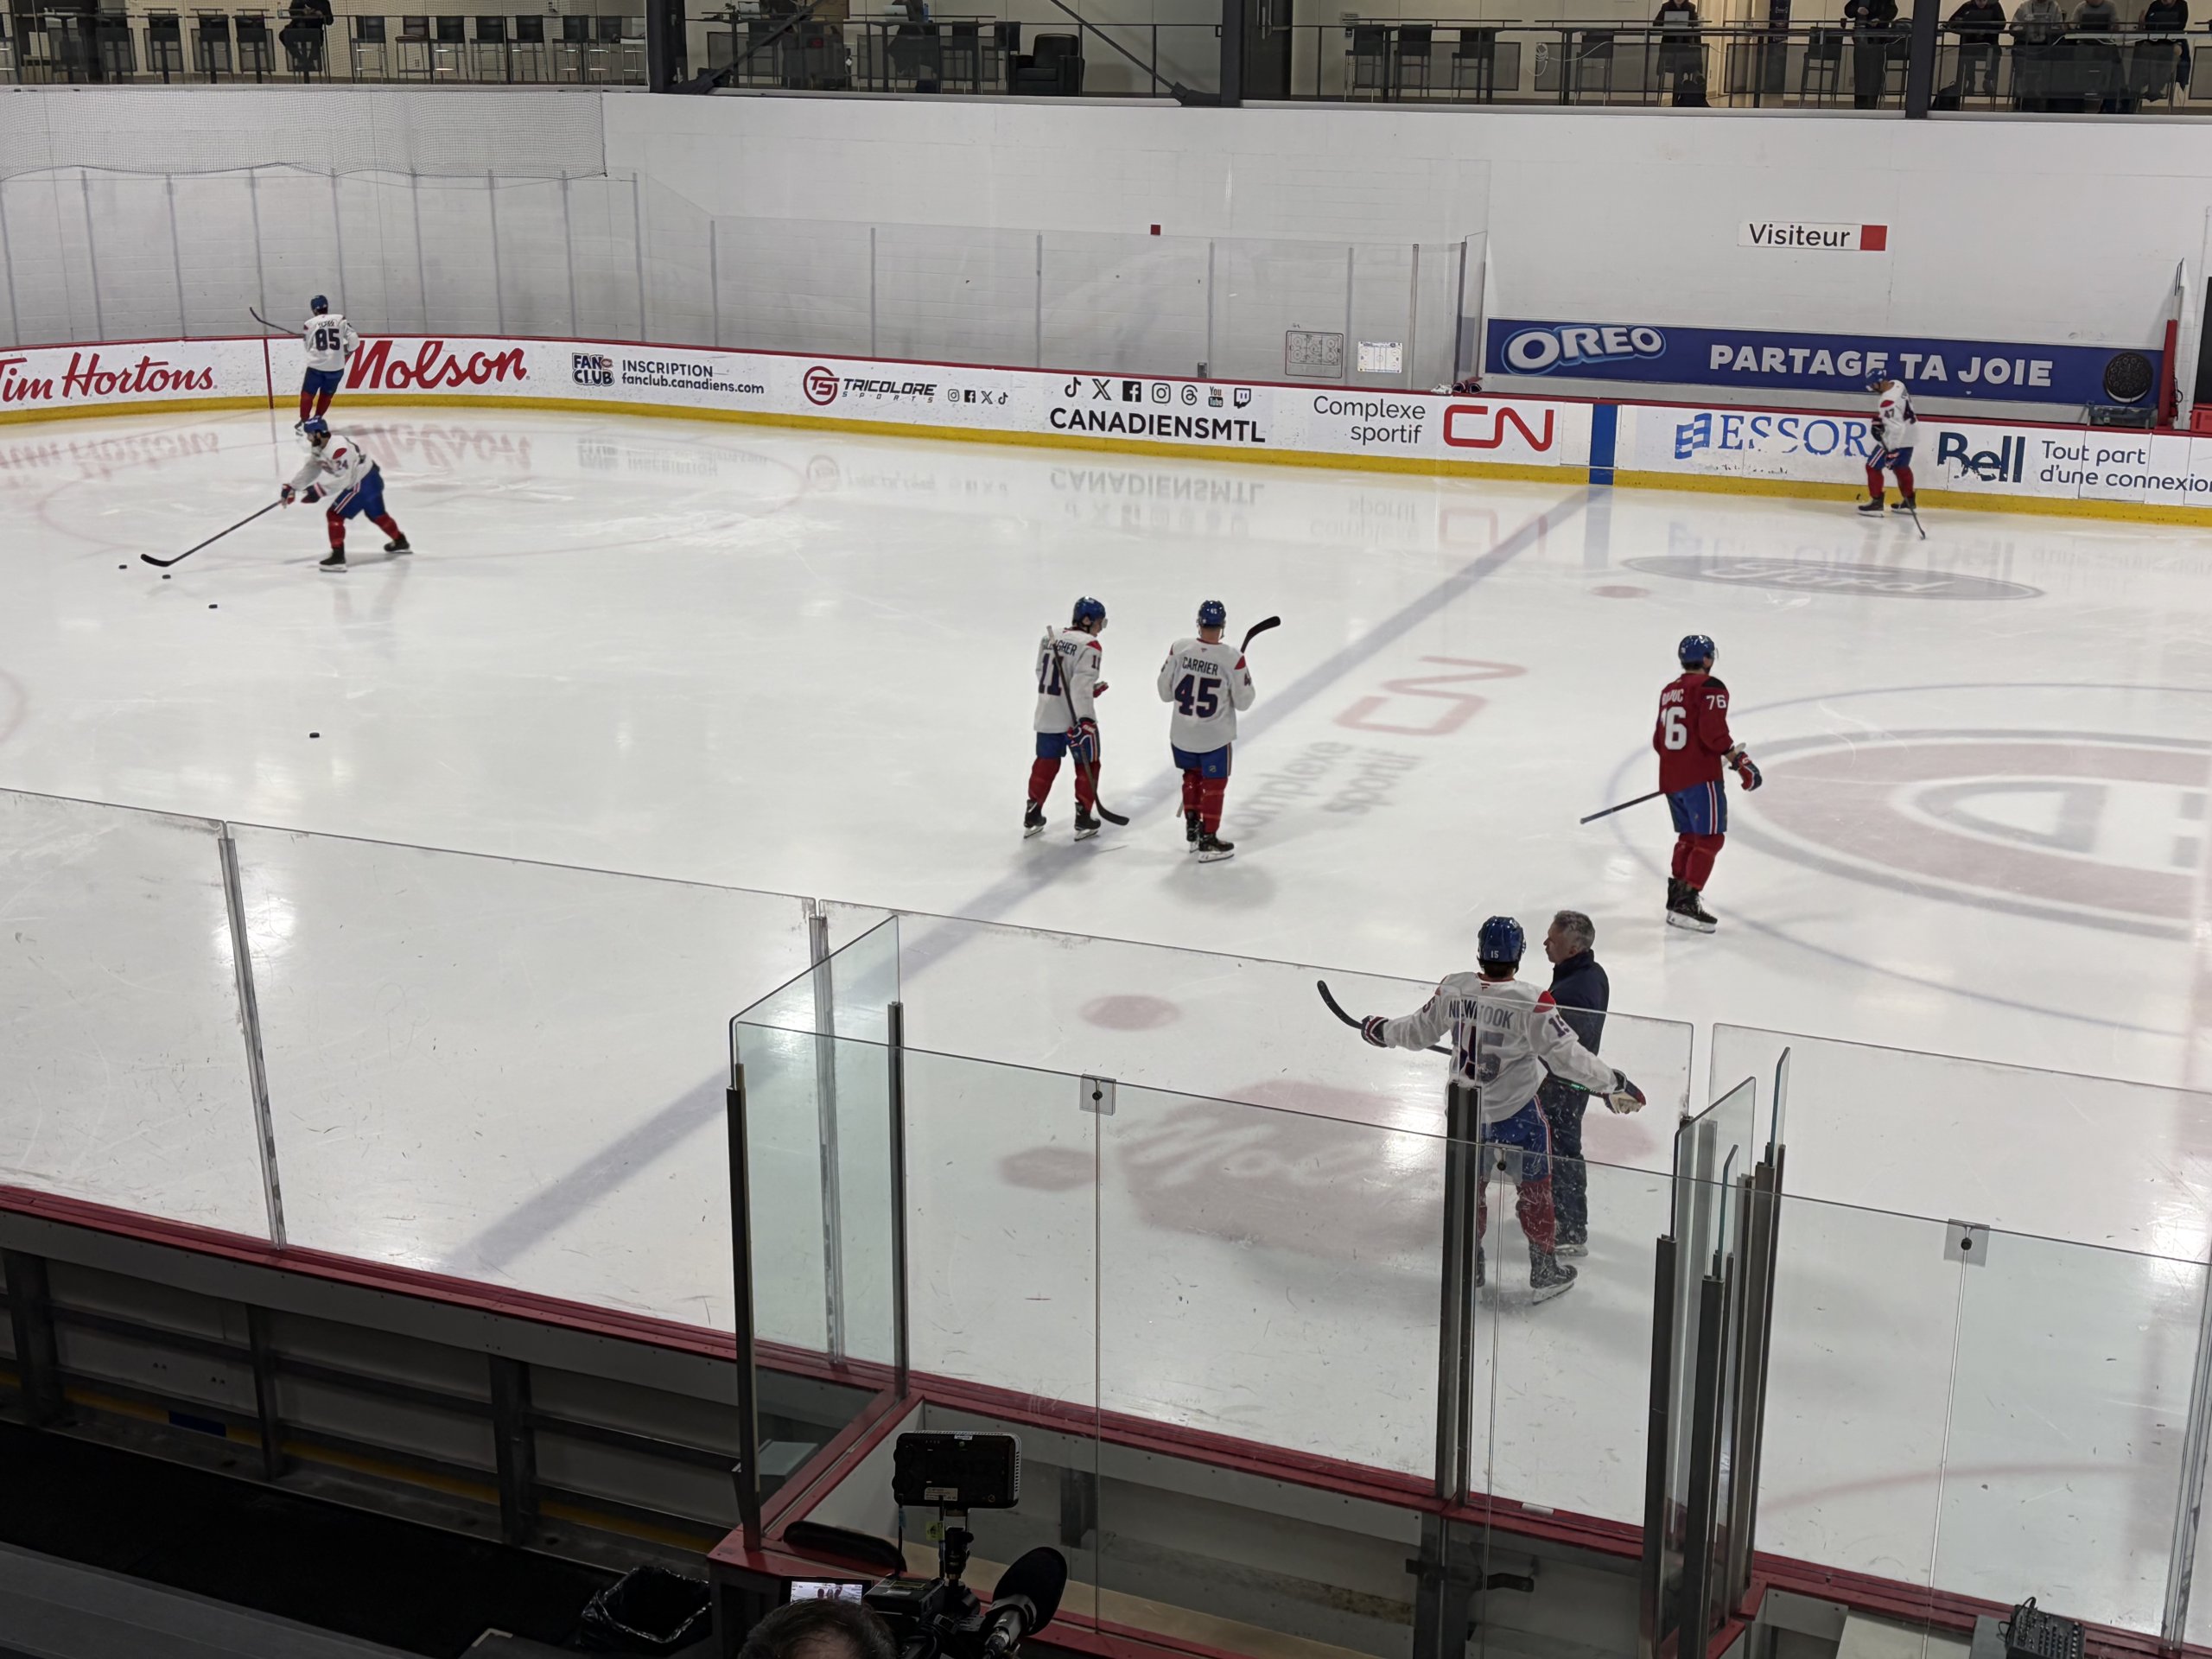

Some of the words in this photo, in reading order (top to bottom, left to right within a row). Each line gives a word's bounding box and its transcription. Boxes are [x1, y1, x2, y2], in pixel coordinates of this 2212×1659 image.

[1749, 223, 1851, 247] Visiteur
[315, 328, 340, 351] 85
[1507, 327, 1662, 369] OREO
[345, 340, 527, 389] Molson
[573, 354, 603, 370] FAN
[622, 359, 714, 377] INSCRIPTION
[1709, 344, 1889, 378] PARTAGE
[1899, 353, 1948, 381] TA
[1958, 356, 2054, 387] JOIE
[0, 357, 54, 402] Tim
[61, 352, 213, 397] Hortons
[573, 369, 613, 385] CLUB
[621, 372, 765, 394] fanclub.canadiens.com
[843, 378, 938, 396] TRICOLORE
[1313, 395, 1426, 422] Complexe
[1049, 407, 1266, 443] CANADIENSMTL
[1350, 424, 1423, 445] sportif
[1443, 404, 1555, 452] CN
[1717, 414, 1872, 458] ESSOR
[1937, 431, 2026, 483] Bell
[2041, 440, 2090, 461] Tout
[2096, 448, 2146, 467] part
[2040, 464, 2099, 485] d'une
[2106, 473, 2212, 493] connexio
[1038, 652, 1065, 696] 11
[1182, 656, 1219, 676] CARRIER
[1174, 673, 1223, 718] 45
[1706, 694, 1727, 710] 76
[1491, 950, 1499, 959] 15
